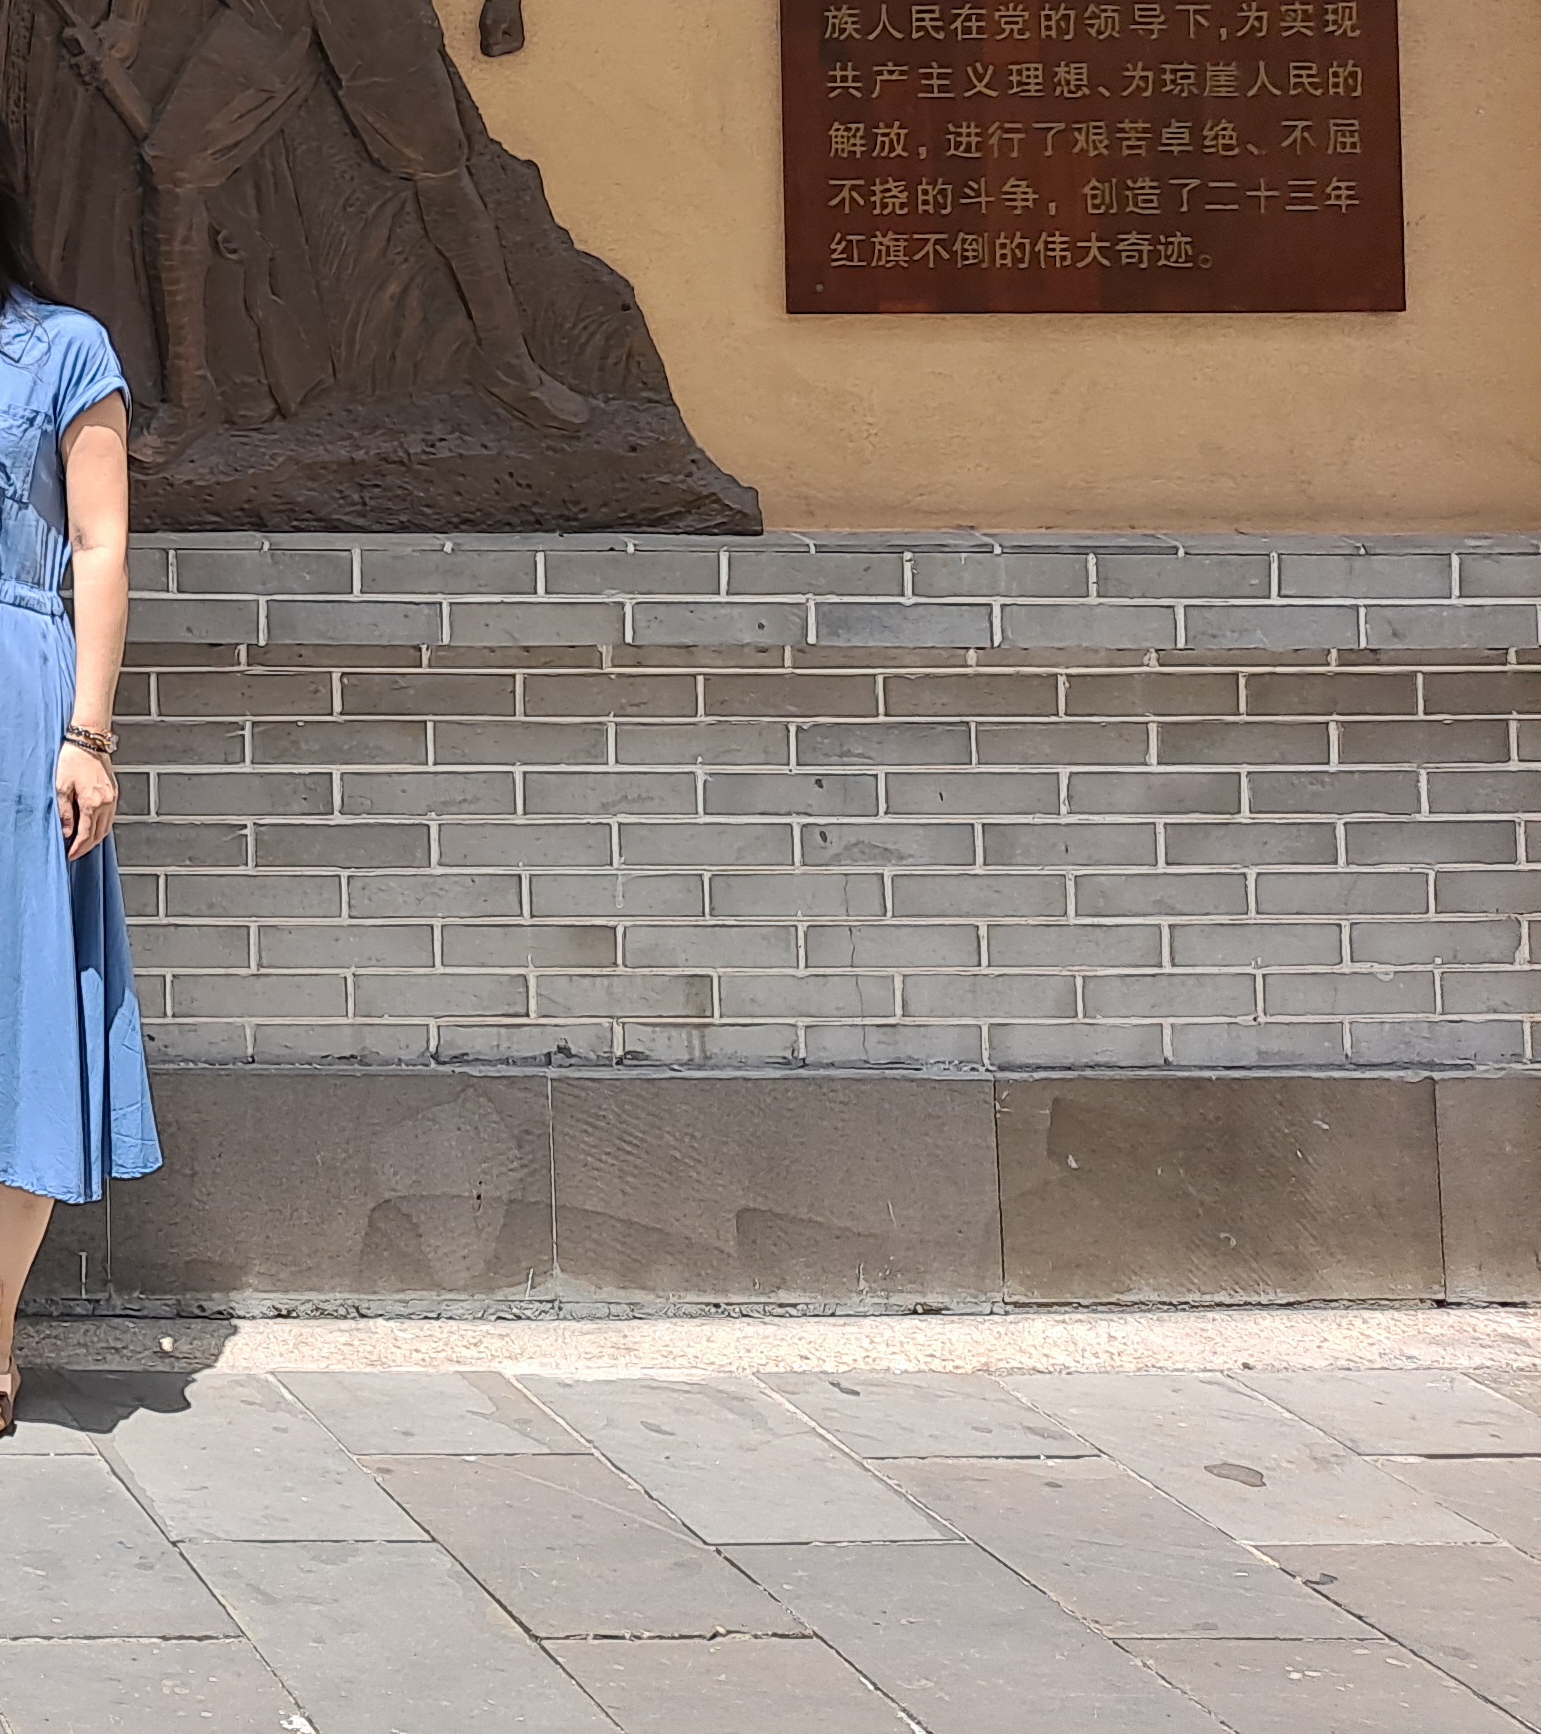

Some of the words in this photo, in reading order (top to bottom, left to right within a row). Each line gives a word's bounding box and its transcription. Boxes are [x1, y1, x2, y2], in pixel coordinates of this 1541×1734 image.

[826, 60, 1364, 100] 共产主义理想、为琼崖人民的
[827, 119, 1363, 159] 解放，进行了艰苦卓绝、不屈
[827, 176, 1361, 216] 不挠的斗争，创造了二十三年
[828, 231, 1214, 270] 红旗不倒的伟大奇迹。
